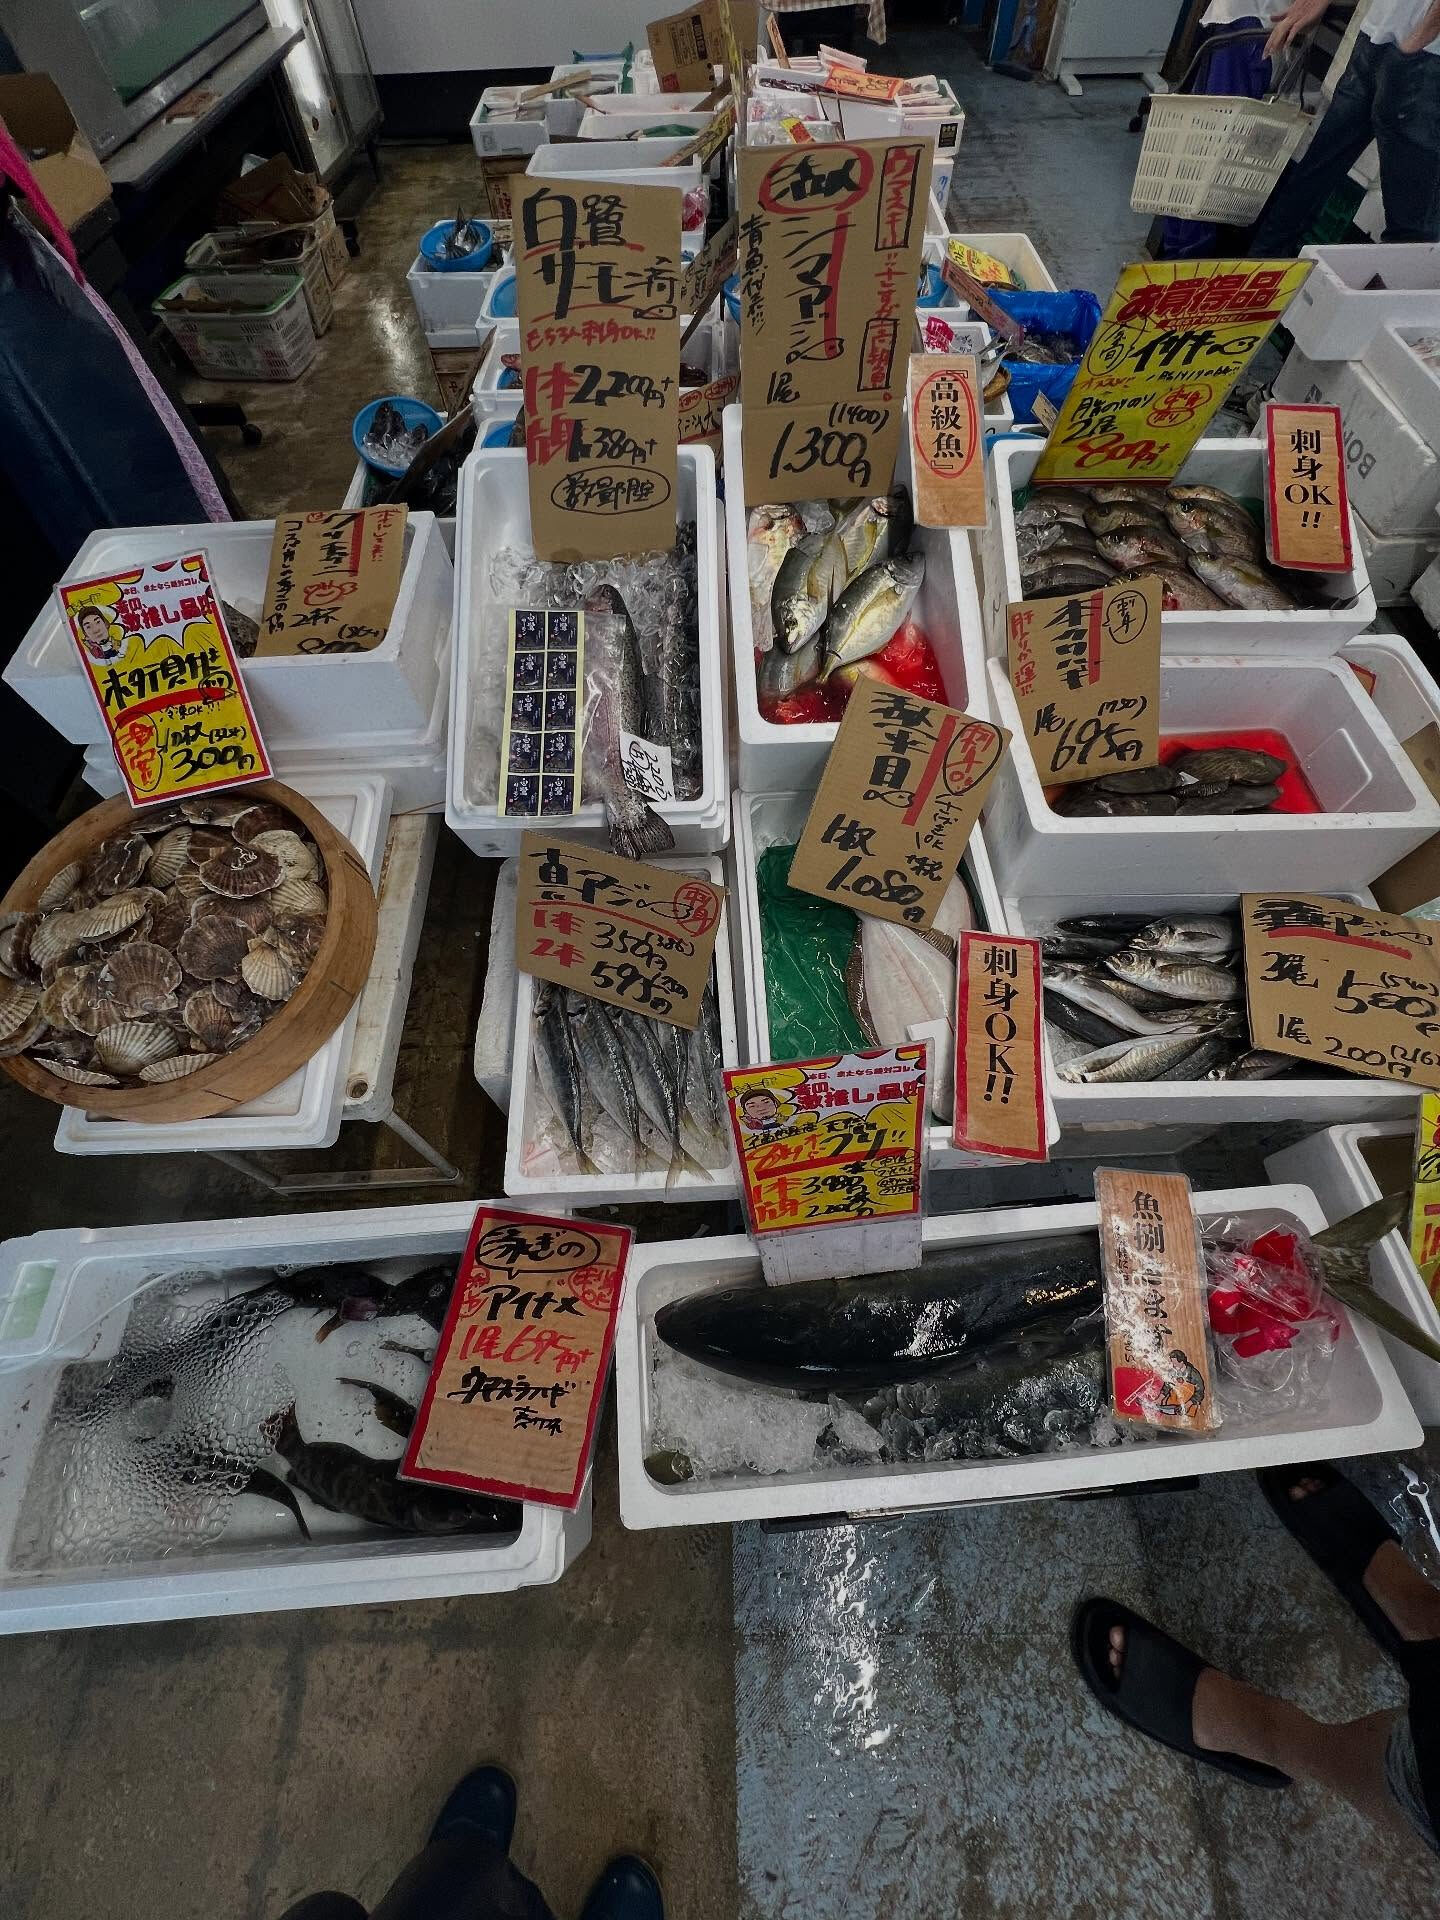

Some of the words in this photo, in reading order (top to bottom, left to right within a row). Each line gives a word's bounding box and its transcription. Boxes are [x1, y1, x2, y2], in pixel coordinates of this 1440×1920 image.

[1116, 269, 1288, 323] お買得品
[1168, 317, 1193, 326] BEST
[983, 945, 1019, 1104] 刺身OK!!
[482, 1284, 588, 1320] アイナメ
